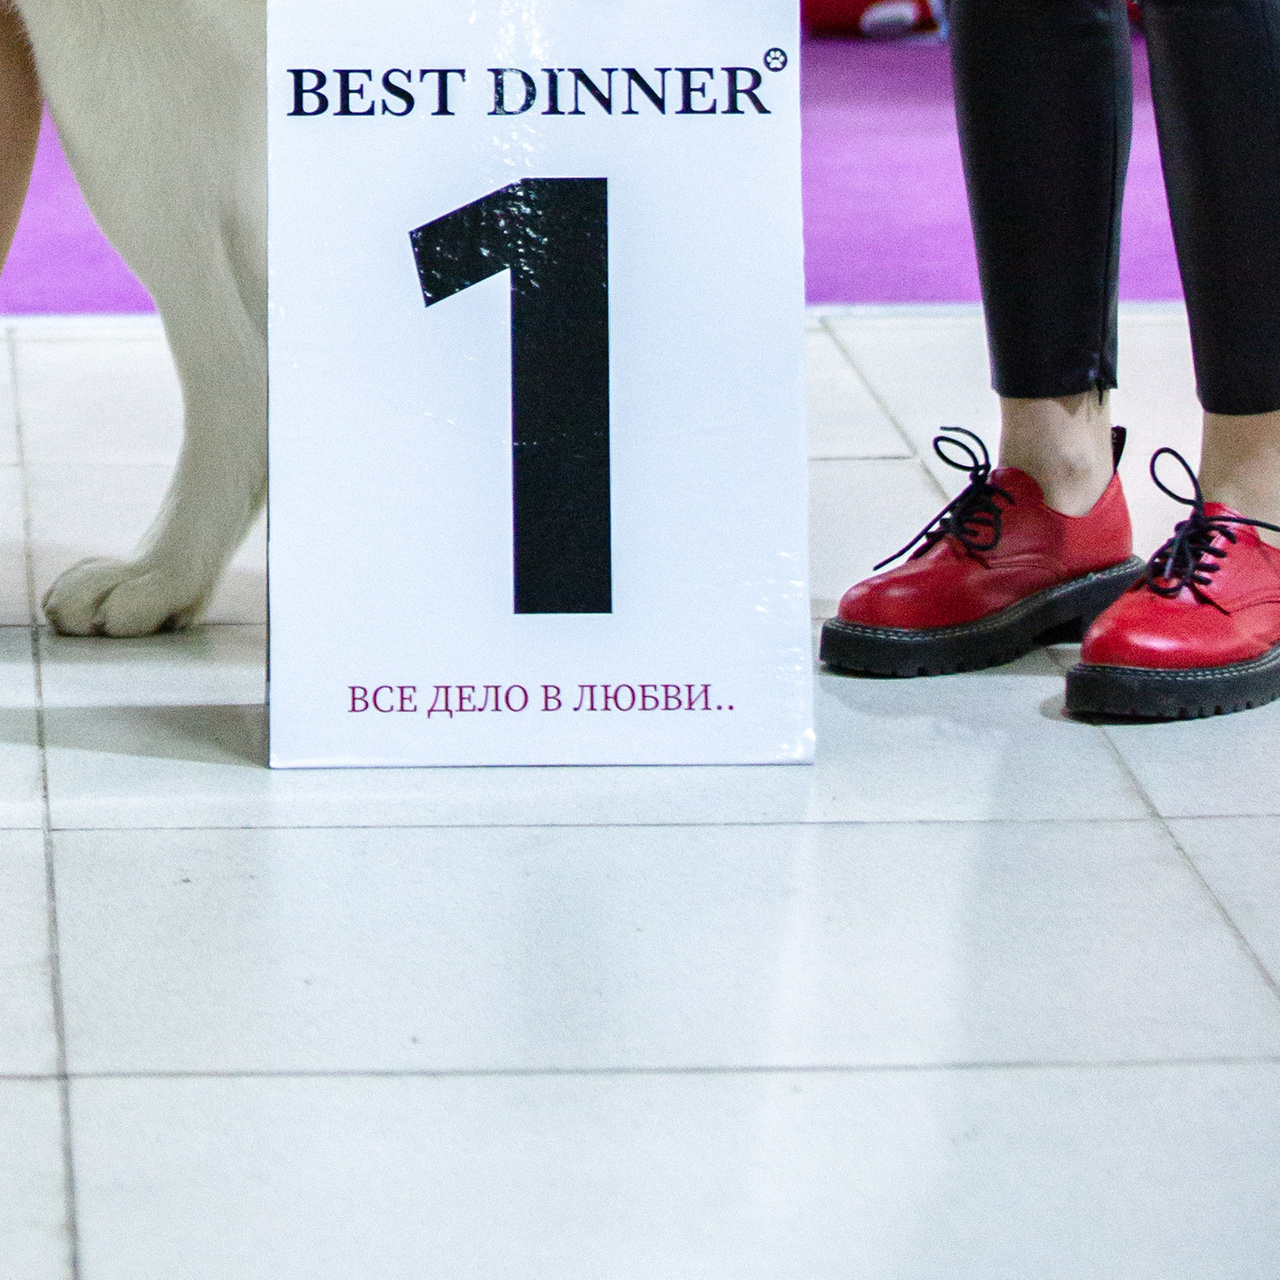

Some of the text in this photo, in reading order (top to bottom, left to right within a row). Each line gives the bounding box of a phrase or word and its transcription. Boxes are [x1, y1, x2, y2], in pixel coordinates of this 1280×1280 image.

[286, 67, 772, 117] BEST DINNER
[408, 177, 613, 615] 1
[348, 683, 735, 719] ВСЕ ДЕЛО В ЛЮБВИ..
